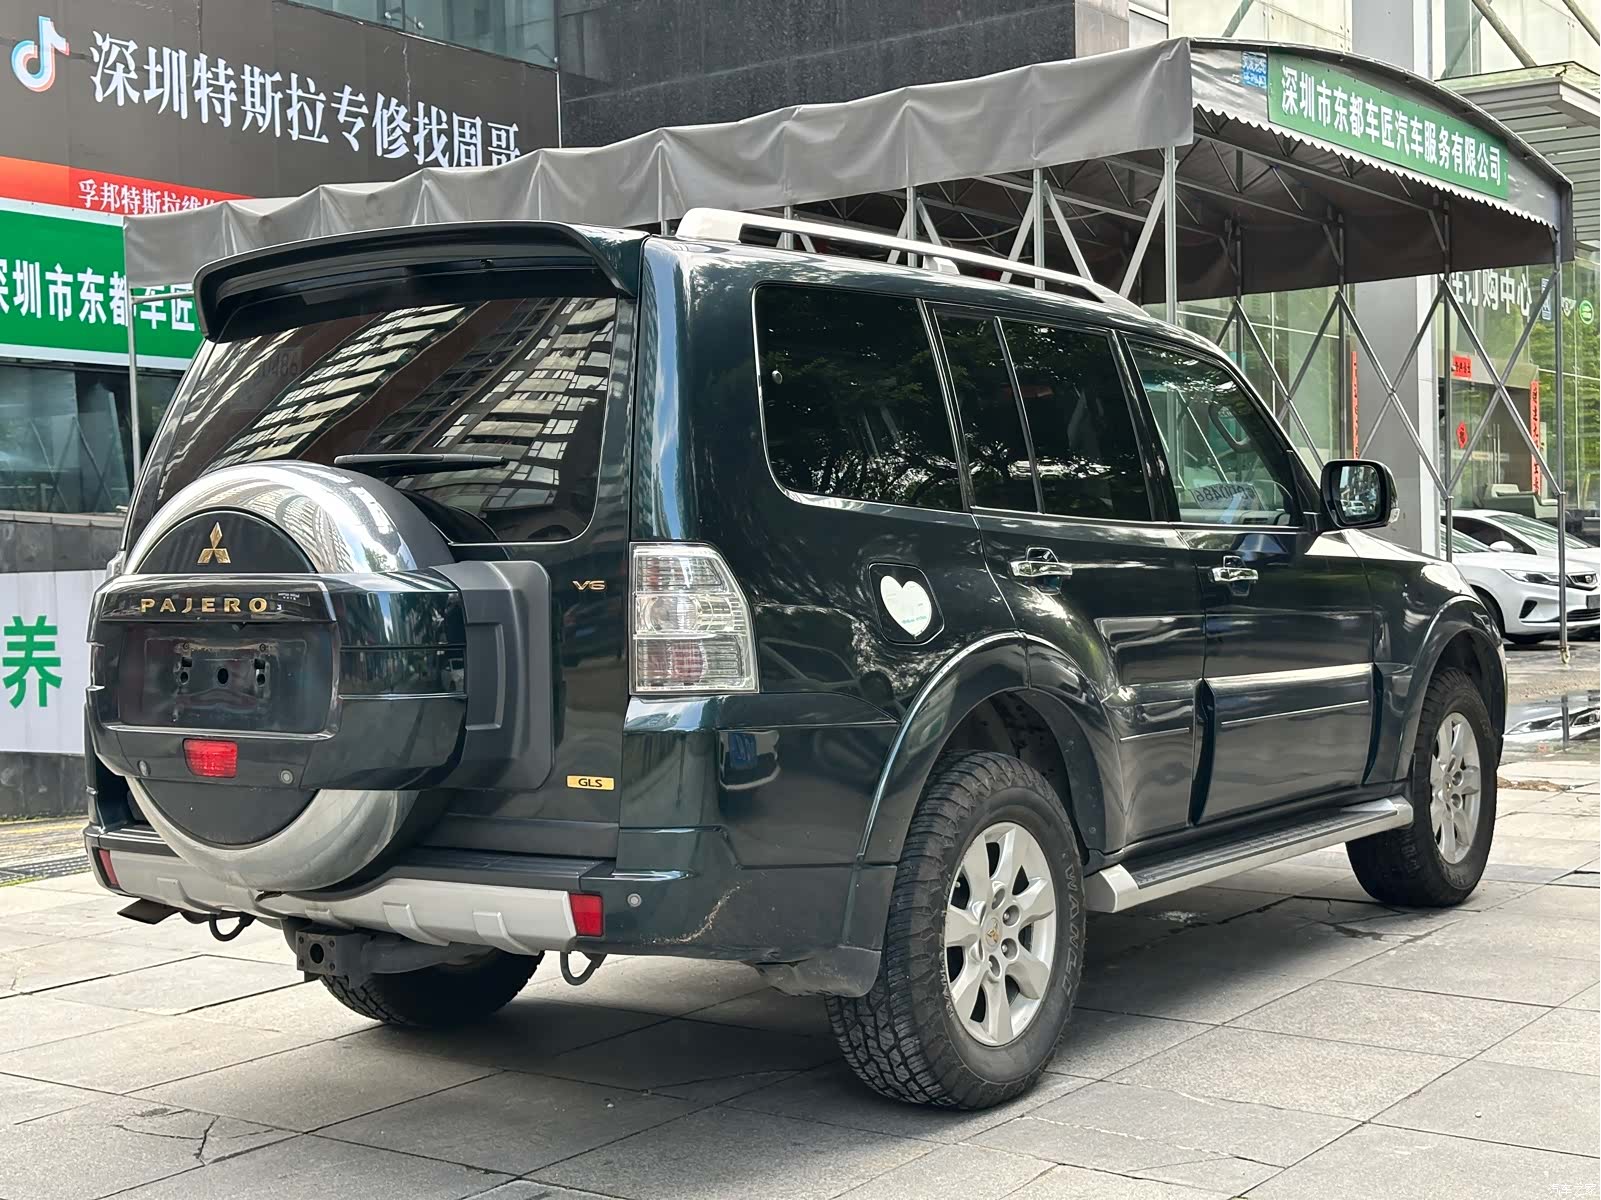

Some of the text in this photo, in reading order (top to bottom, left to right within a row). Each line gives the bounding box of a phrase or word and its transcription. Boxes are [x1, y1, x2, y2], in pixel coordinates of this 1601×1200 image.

[90, 30, 520, 167] 深圳特斯拉专修找周哥
[1281, 64, 1501, 186] 深圳市东都车匠汽车服务有限公司
[140, 597, 268, 613] PAJERO
[573, 580, 606, 590] V6
[2, 615, 62, 709] 养
[578, 778, 602, 788] GLS
